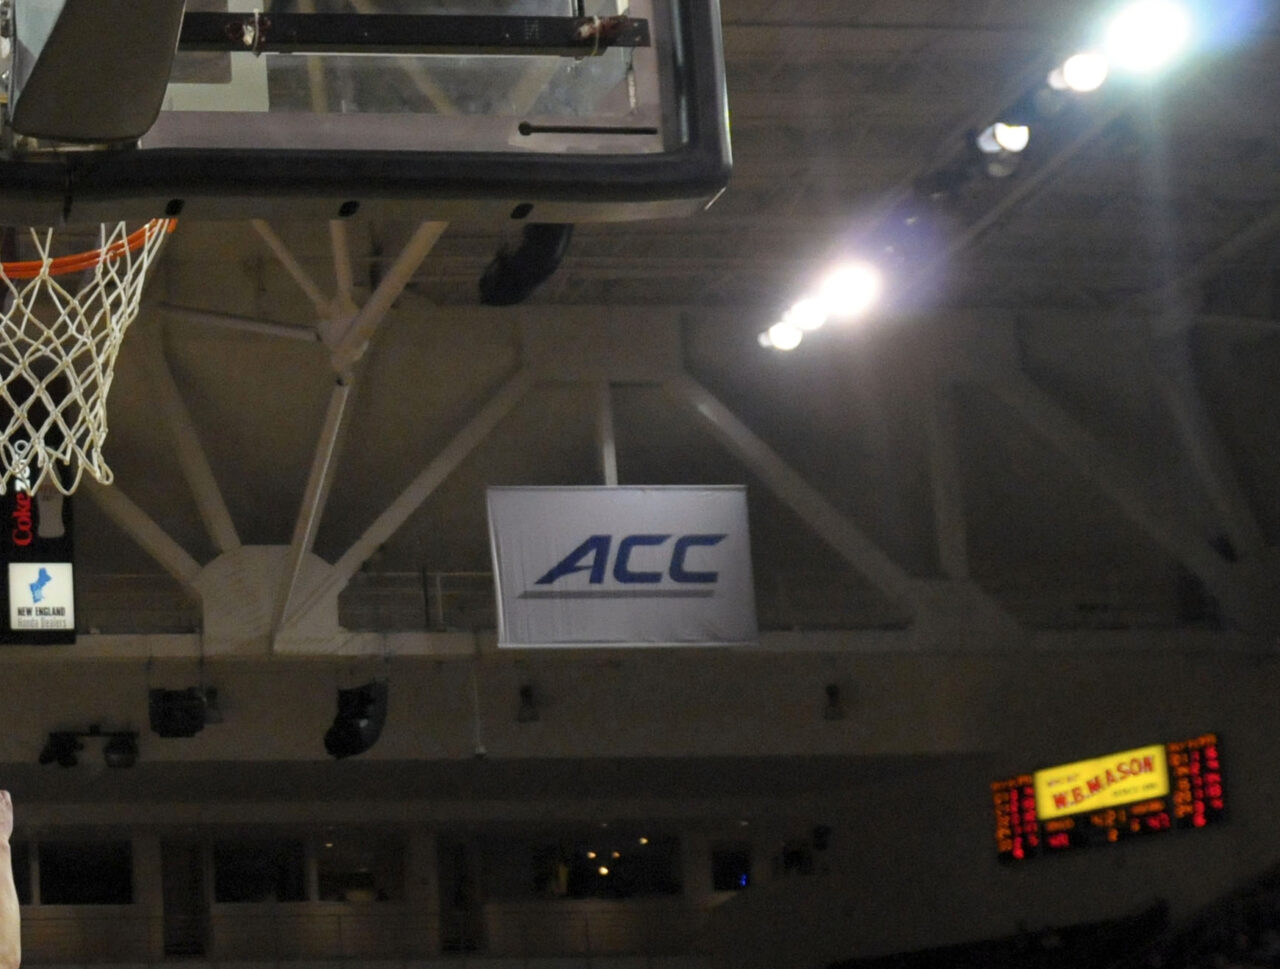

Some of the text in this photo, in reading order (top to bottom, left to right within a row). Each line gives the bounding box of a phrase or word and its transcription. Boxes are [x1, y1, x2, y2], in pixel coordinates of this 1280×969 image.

[533, 533, 729, 585] ACC
[17, 606, 66, 617] NEW ENGLAND
